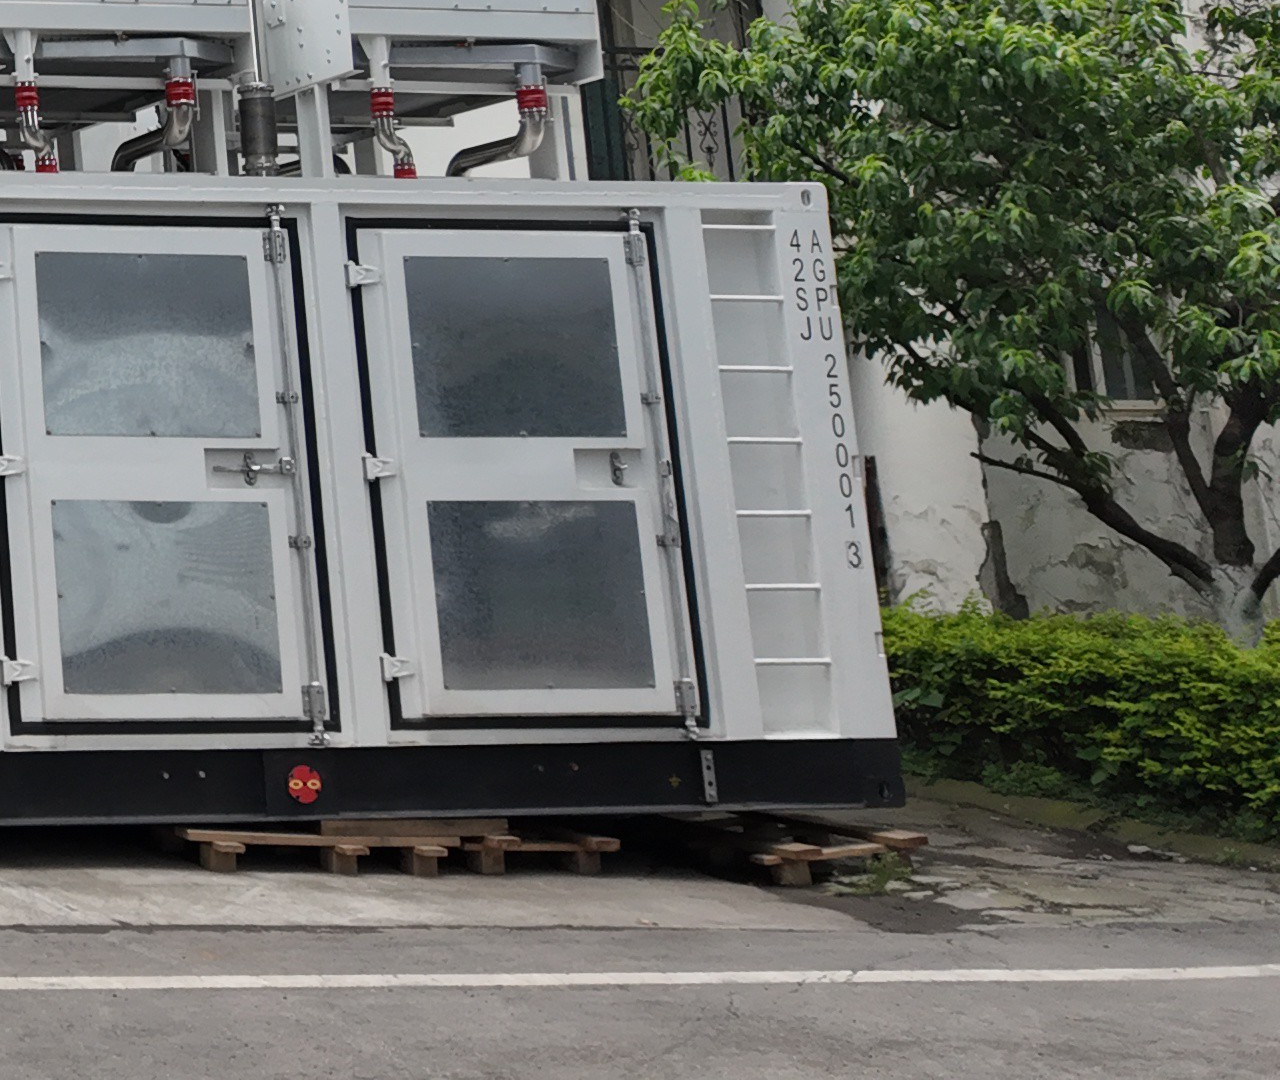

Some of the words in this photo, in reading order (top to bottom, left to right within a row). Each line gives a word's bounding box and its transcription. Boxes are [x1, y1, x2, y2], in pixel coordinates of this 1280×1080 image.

[810, 228, 834, 342] AGPU
[824, 353, 855, 530] 250001
[846, 542, 863, 569] 3
